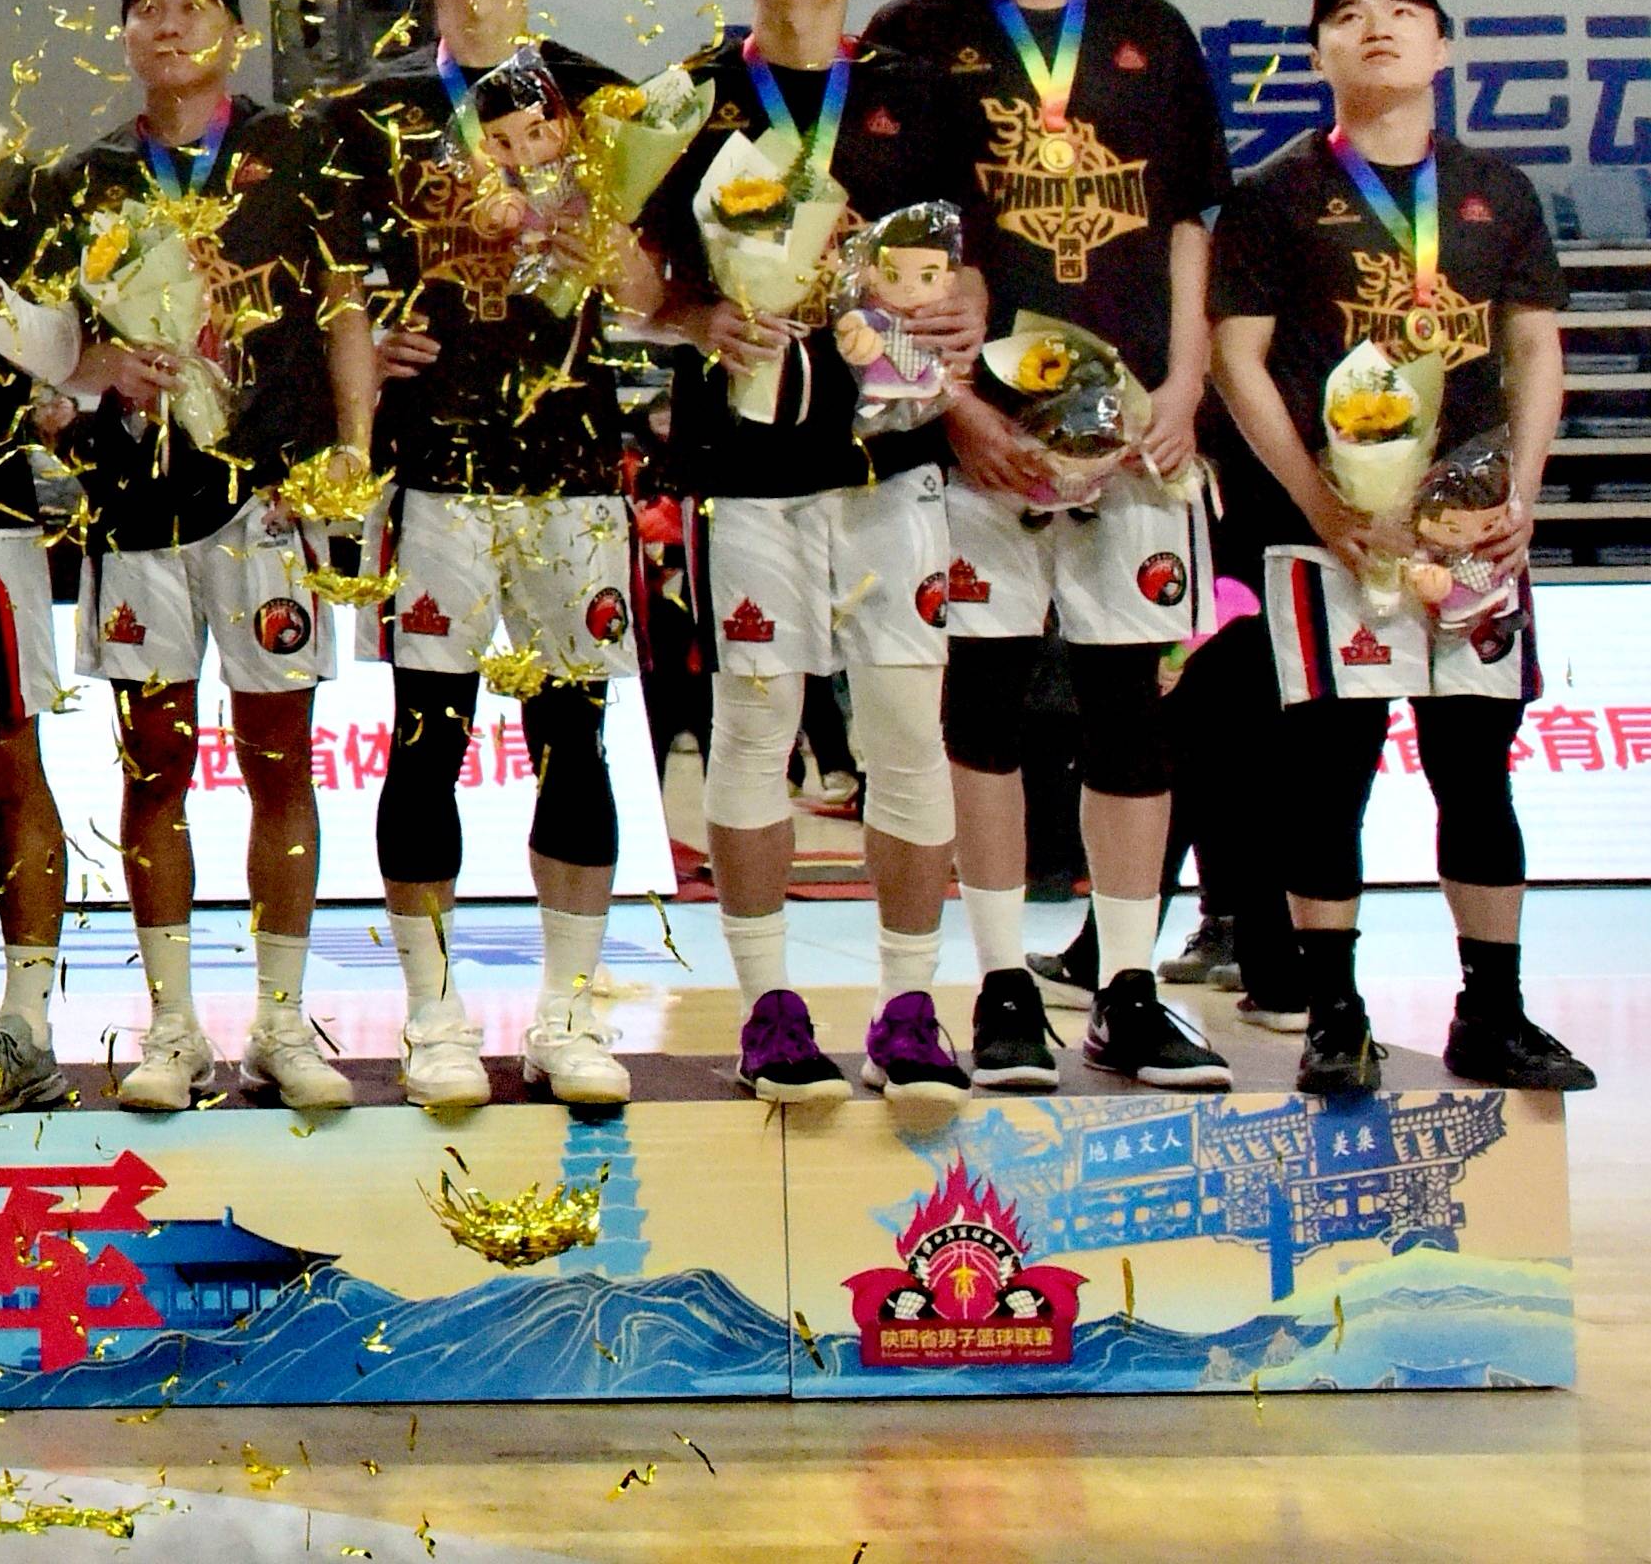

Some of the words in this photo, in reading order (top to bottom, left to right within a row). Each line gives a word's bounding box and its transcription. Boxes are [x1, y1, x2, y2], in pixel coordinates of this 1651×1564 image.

[880, 1327, 1053, 1350] 陕西省男子篮球联赛
